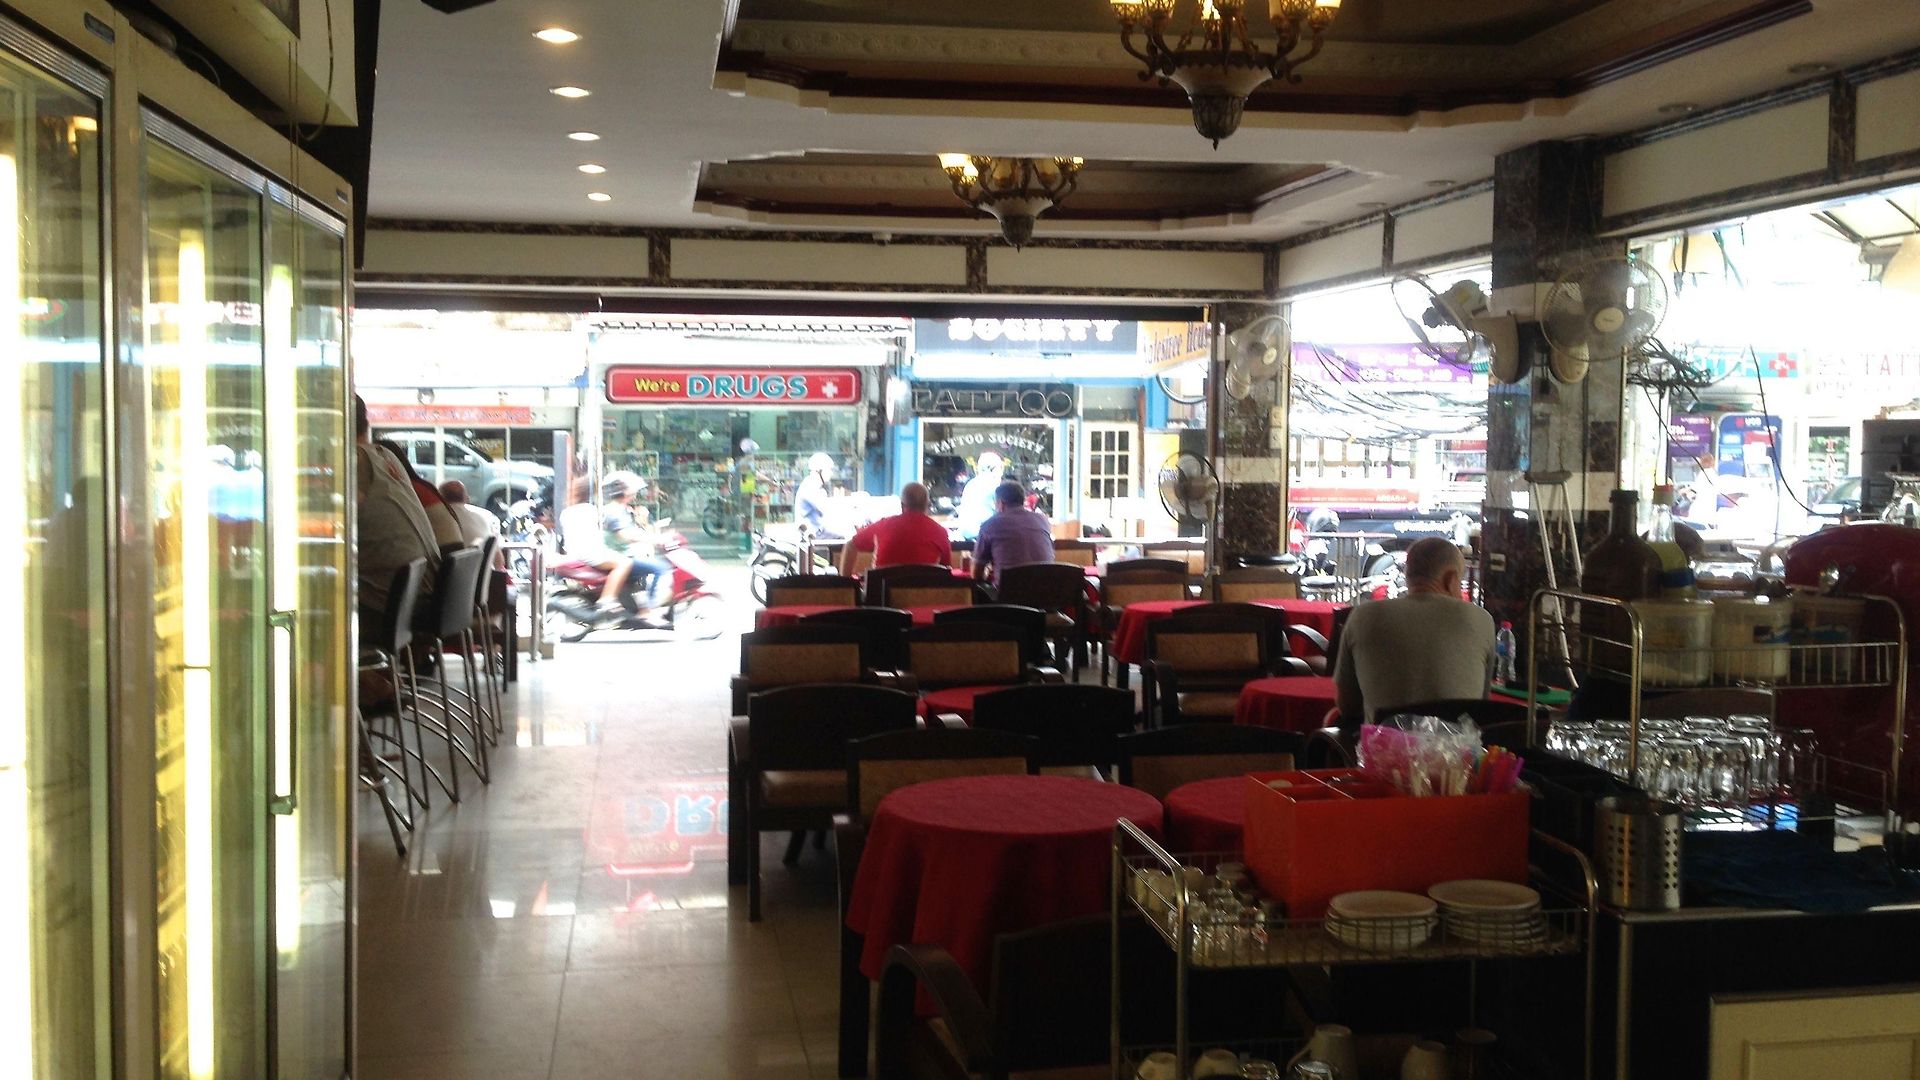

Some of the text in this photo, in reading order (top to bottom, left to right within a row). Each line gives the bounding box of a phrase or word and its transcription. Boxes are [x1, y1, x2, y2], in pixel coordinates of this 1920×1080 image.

[634, 374, 808, 399] We're DRUGS
[911, 388, 1073, 417] TATTOO
[930, 431, 1045, 455] TATTOO SOCIETY
